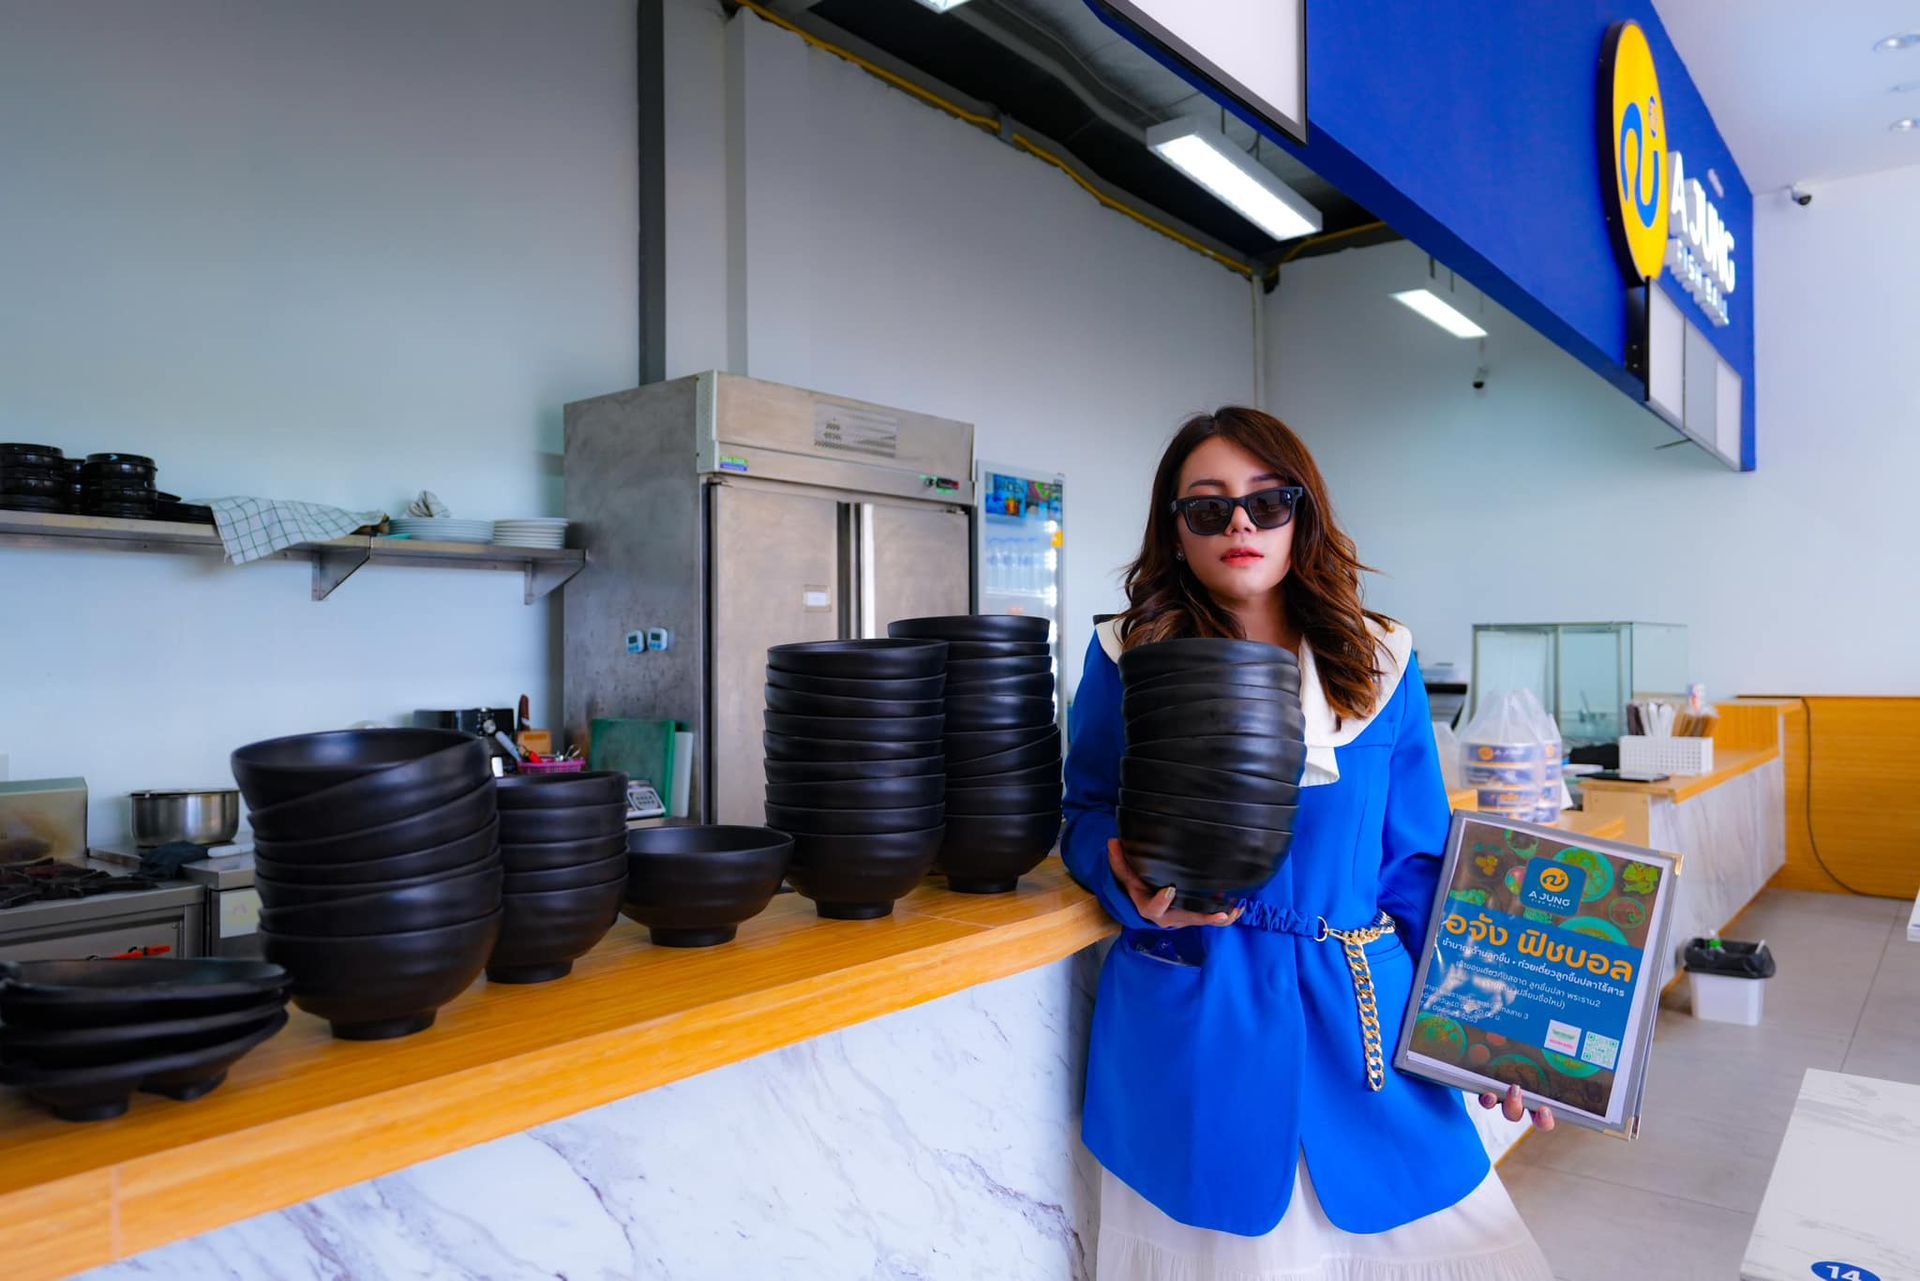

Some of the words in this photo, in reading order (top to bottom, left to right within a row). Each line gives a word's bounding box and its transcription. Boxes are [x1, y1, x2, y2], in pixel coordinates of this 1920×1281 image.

[1671, 151, 1688, 233] A
[1689, 178, 1735, 293] JUNG
[1528, 890, 1538, 899] A
[1539, 893, 1570, 907] JUNG
[1445, 913, 1508, 946] อจัง
[1517, 929, 1634, 982] ฟิชบอล
[1826, 1265, 1862, 1281] 14
